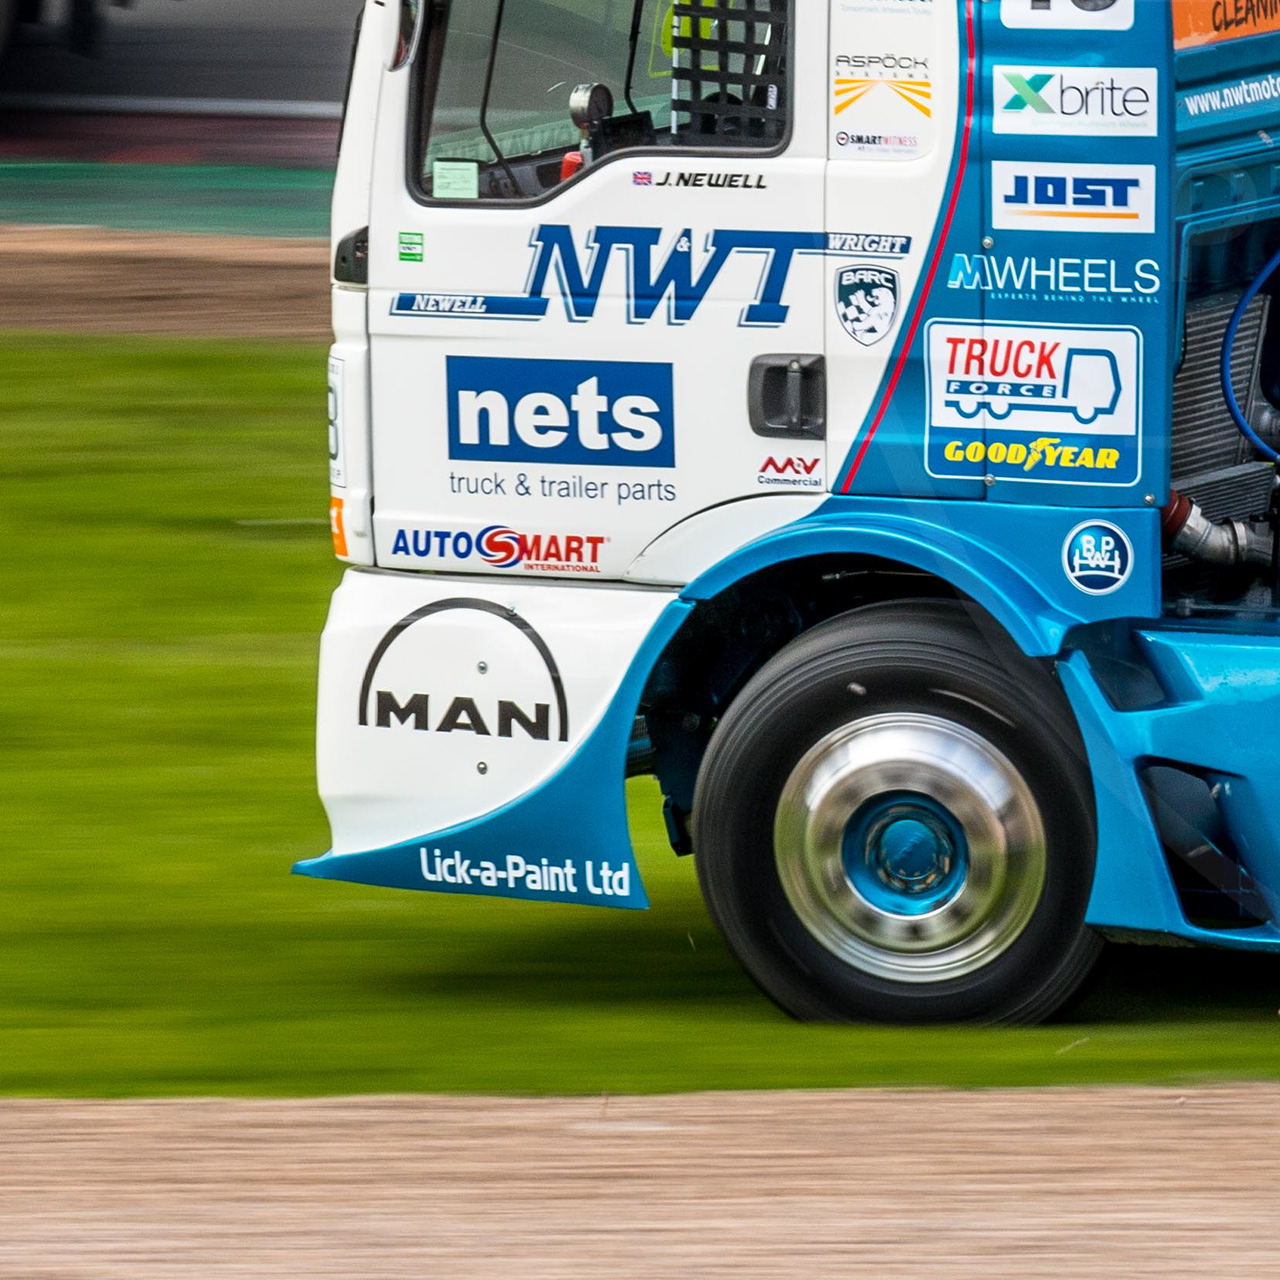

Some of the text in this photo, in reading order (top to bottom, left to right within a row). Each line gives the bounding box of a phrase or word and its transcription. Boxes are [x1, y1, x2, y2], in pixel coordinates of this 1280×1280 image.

[836, 53, 929, 69] ASPÖCK
[1003, 176, 1139, 207] JOST
[676, 236, 692, 253] &
[827, 233, 907, 254] WRIGHT
[527, 224, 826, 327] NWT
[841, 270, 894, 287] BARC
[412, 294, 487, 313] NEWELL
[946, 336, 1061, 381] TRUCK
[947, 382, 1055, 399] FORCE
[457, 376, 664, 452] nets
[943, 436, 1119, 472] GOODYEAR
[449, 472, 678, 507] truck & trailer parts
[757, 476, 822, 487] Commercial
[524, 563, 601, 573] INTERNATIONAL
[375, 690, 551, 741] MAN
[420, 847, 629, 896] Lick-a-Paint Ltd
